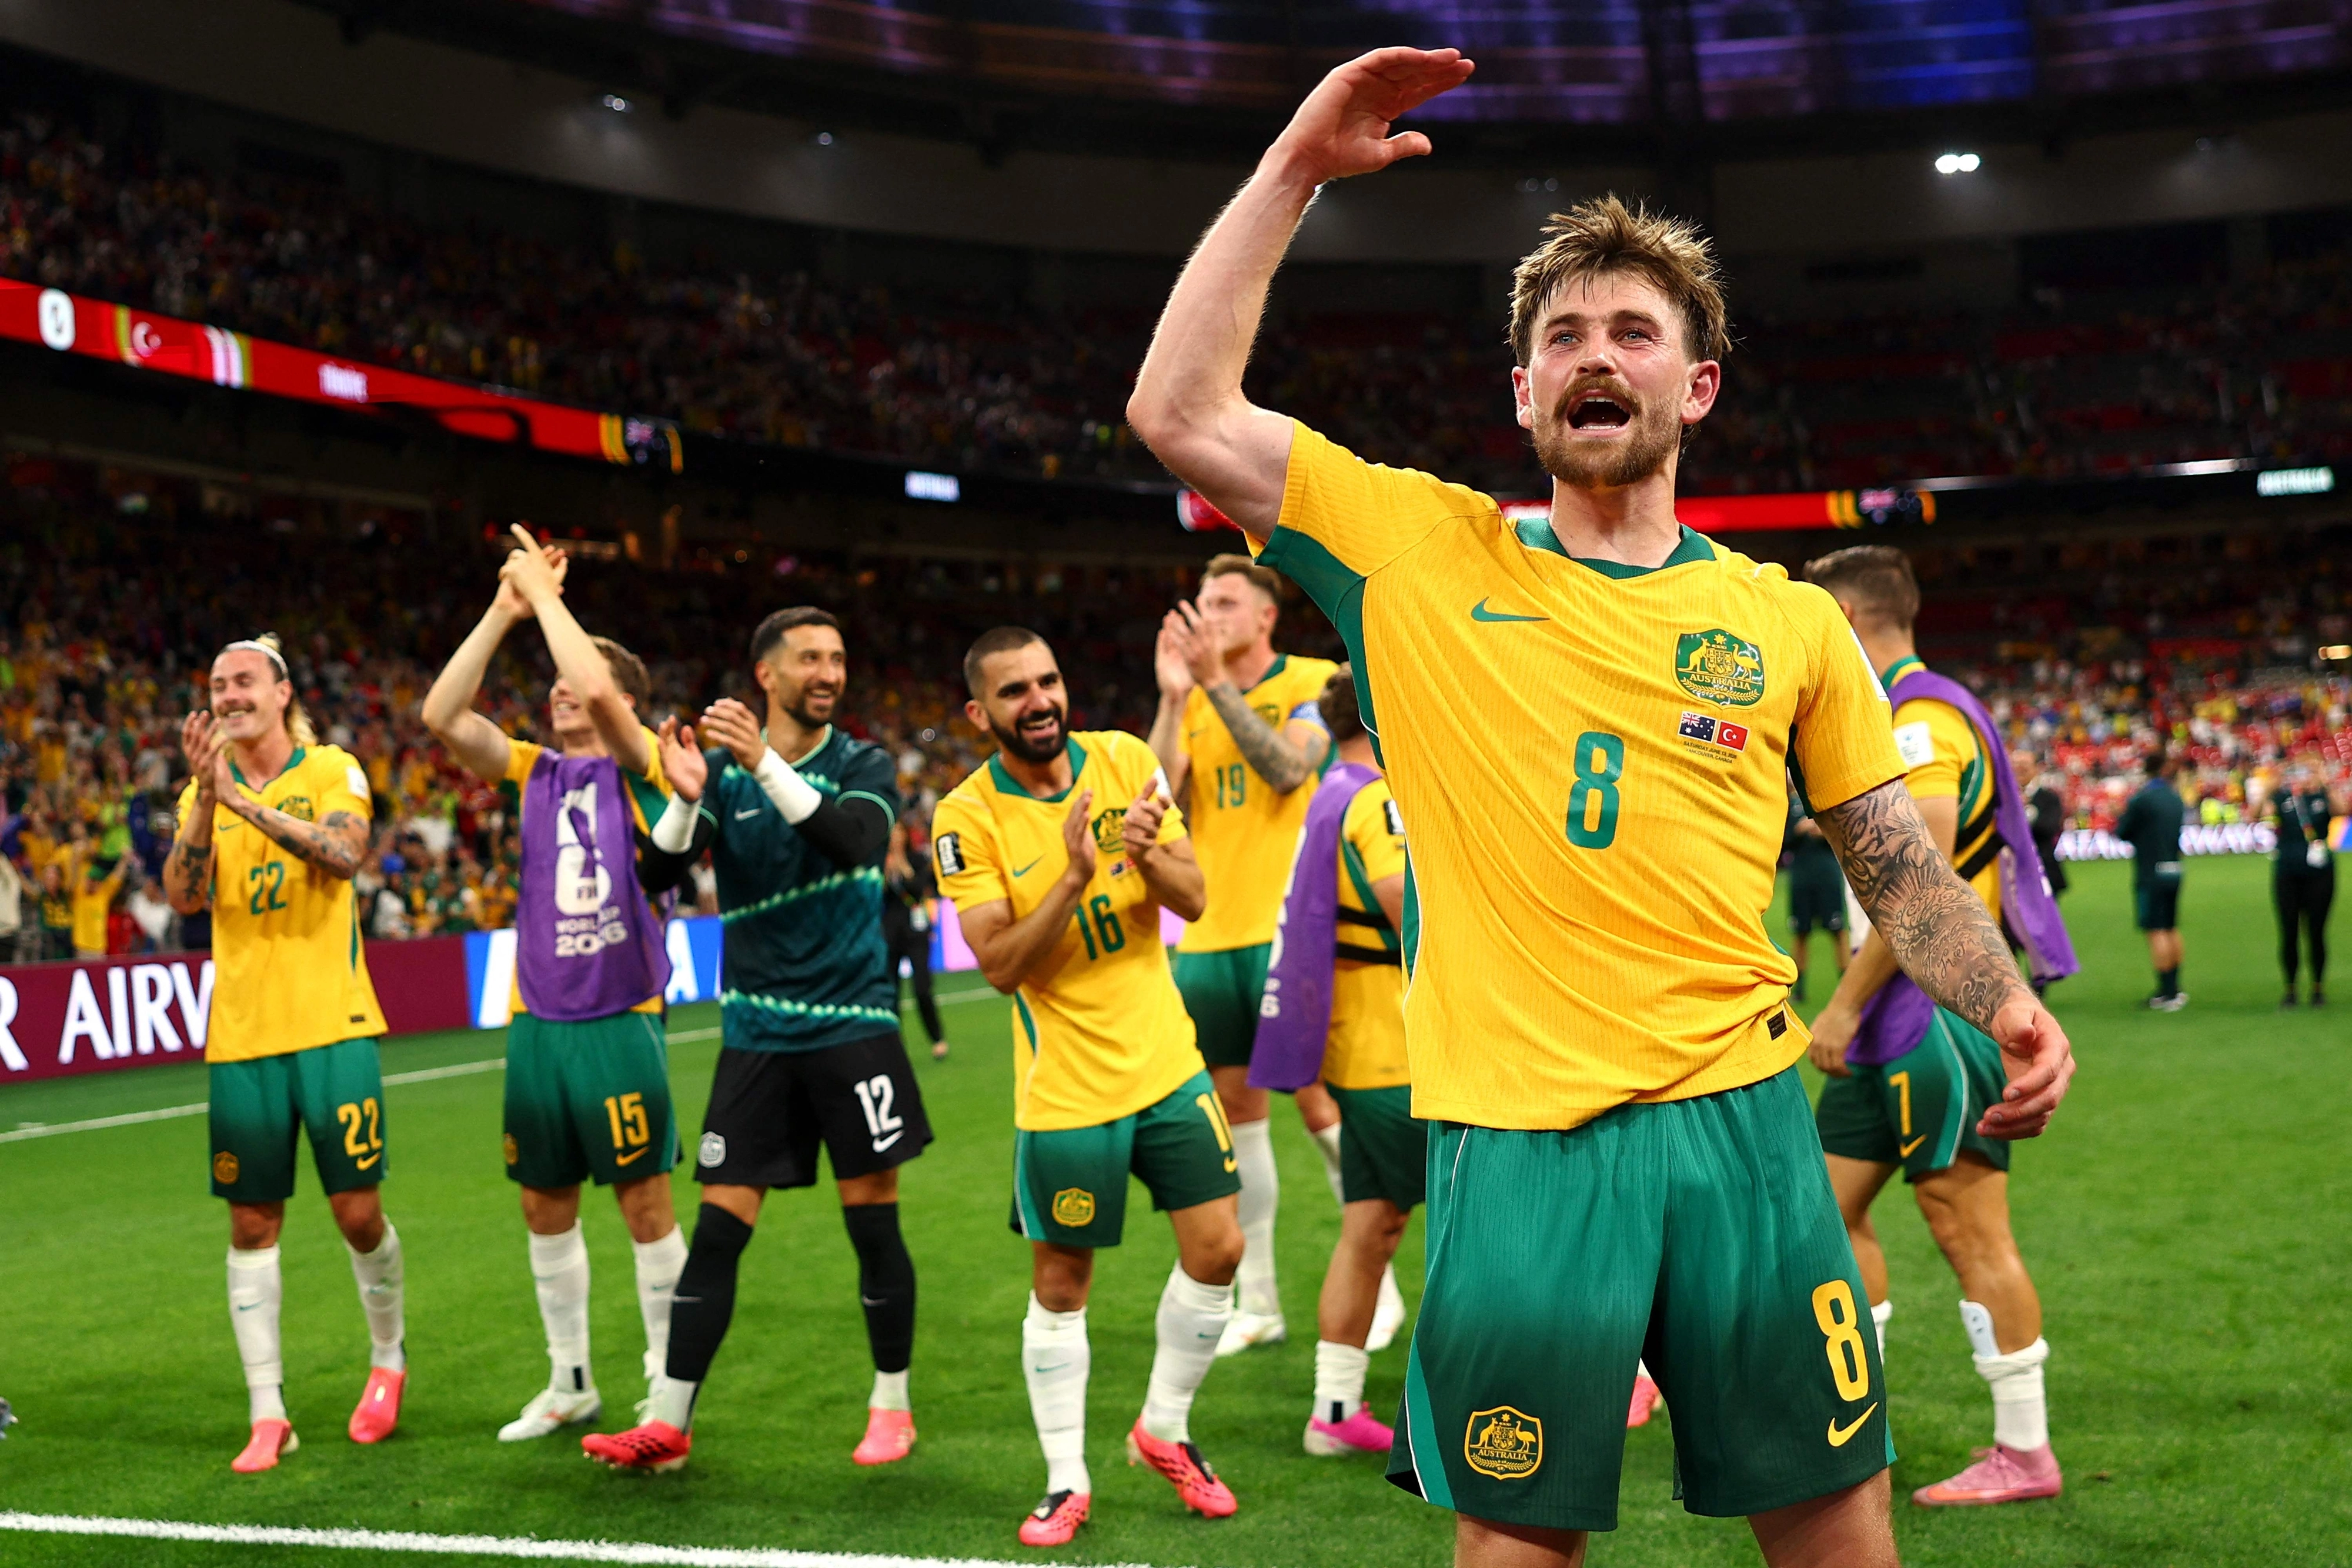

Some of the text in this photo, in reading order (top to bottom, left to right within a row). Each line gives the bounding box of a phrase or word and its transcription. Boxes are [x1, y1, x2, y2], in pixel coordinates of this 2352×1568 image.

[38, 288, 76, 351] 0
[1689, 673, 1752, 691] AUSTRALIA
[1683, 741, 1708, 751] SATURDAY
[1715, 755, 1733, 763] CANADA
[1216, 763, 1246, 810] 19
[1565, 731, 1624, 850] 8
[250, 861, 287, 915] 22
[1075, 894, 1125, 961] 16
[337, 1097, 383, 1157] 22
[604, 1091, 650, 1149] 15
[854, 1074, 903, 1136] 12
[1811, 1279, 1870, 1402] 8
[1477, 1449, 1528, 1461] AUSTRALIA
